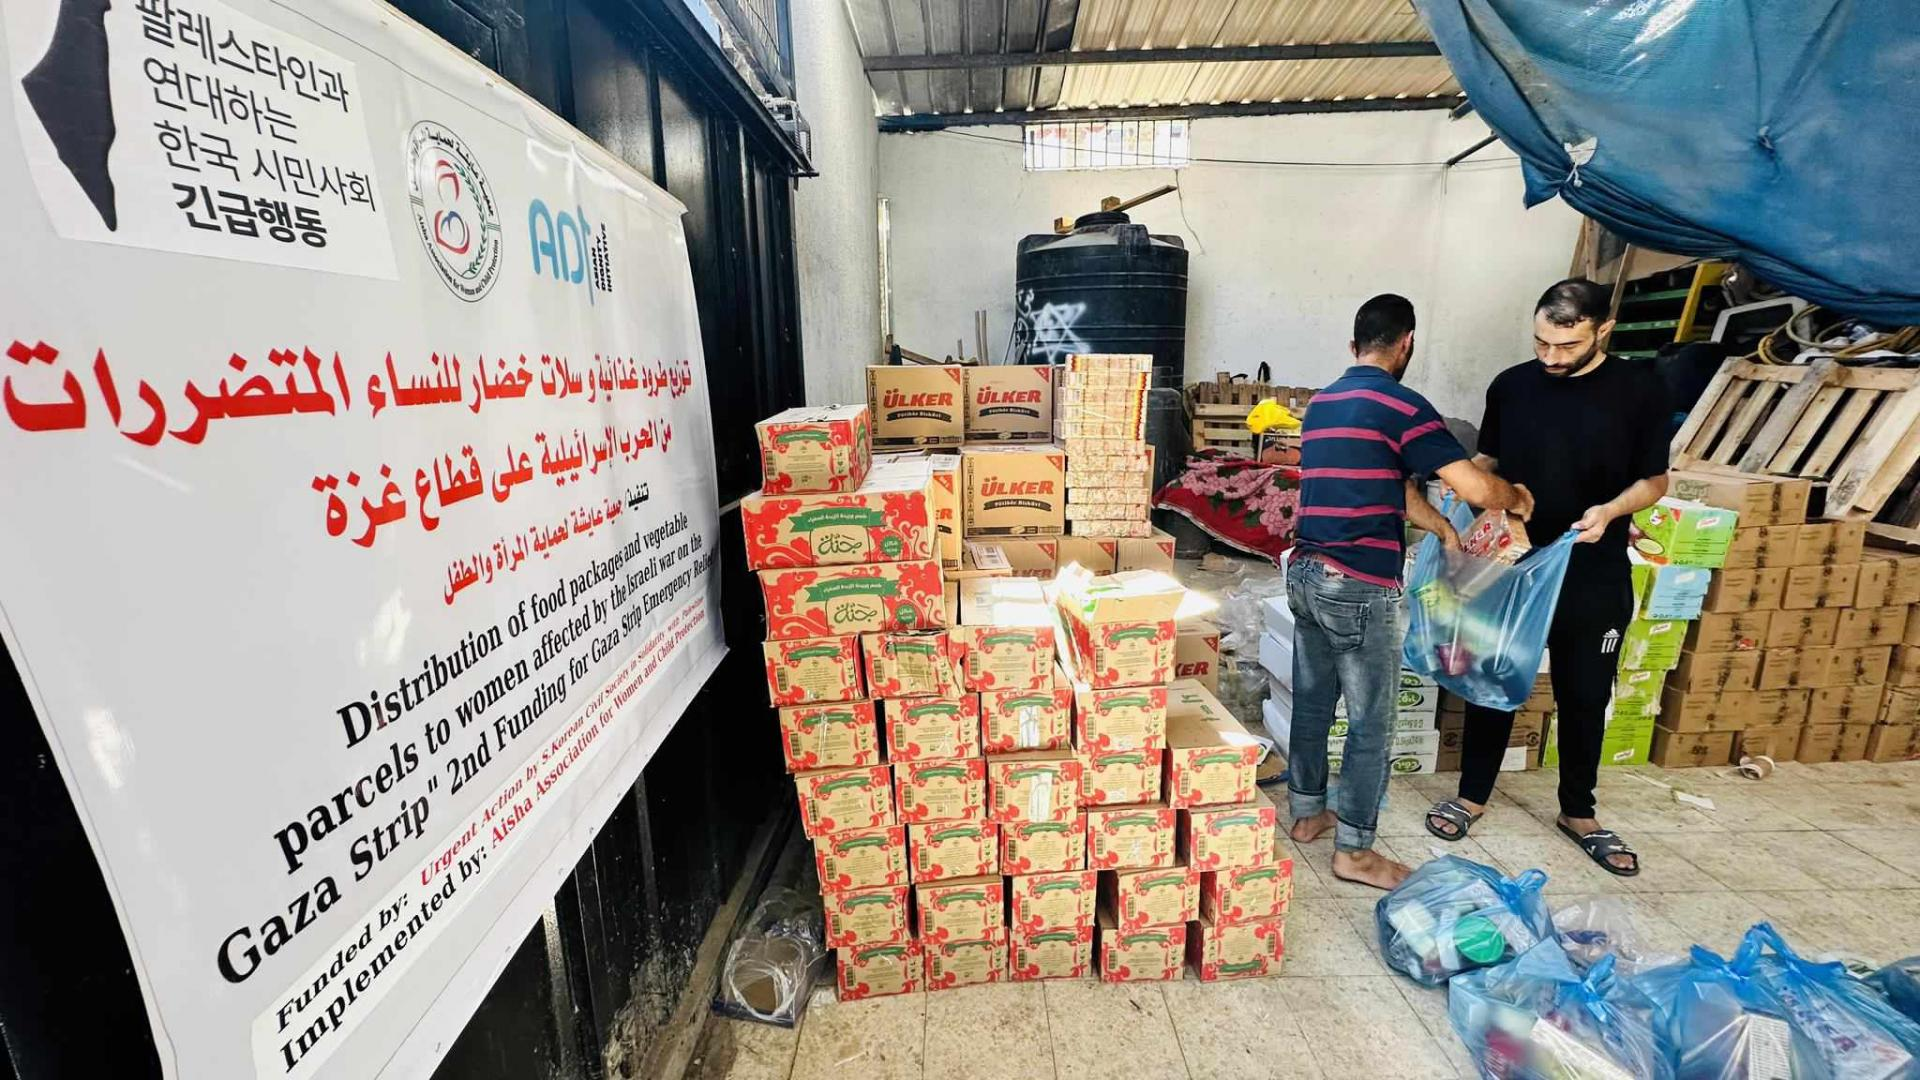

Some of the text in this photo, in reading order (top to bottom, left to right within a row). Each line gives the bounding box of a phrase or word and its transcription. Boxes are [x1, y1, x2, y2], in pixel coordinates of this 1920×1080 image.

[135, 0, 349, 112] 팔레스타인과
[144, 57, 297, 144] 연대하는
[154, 120, 240, 182] 한국
[253, 149, 376, 212] 시민사회
[172, 183, 327, 249] 긴급행동
[3, 340, 351, 446] المتضررات
[367, 351, 462, 418] للنساء
[469, 353, 533, 415] خضار
[642, 359, 668, 397] طرود
[669, 359, 692, 399] توزيع
[883, 388, 953, 408] ÜLKER
[977, 386, 1041, 405] ÜLKER
[620, 420, 658, 463] الحرب
[660, 417, 672, 453] من
[312, 464, 406, 548] غزة
[415, 444, 484, 532] قطاع
[491, 443, 534, 503] على
[981, 477, 1054, 497] ÜLKER
[530, 518, 569, 560] لحماية
[571, 507, 603, 537] عايشة
[444, 551, 493, 605] والطفل
[336, 512, 688, 749] Distribution of food packages and vegetable
[273, 533, 702, 875] parcels to women affected by the Israeli war on the
[216, 876, 342, 984] Gaza
[446, 731, 492, 795] 2nd
[493, 674, 567, 752] Funding
[569, 653, 591, 686] for
[591, 630, 621, 663] Gaza
[621, 604, 643, 637] Strip
[644, 568, 692, 615] Emergency
[276, 924, 373, 1033] Funded
[379, 892, 408, 931] by:
[421, 822, 478, 887] Urgent
[481, 779, 523, 828] Action
[526, 760, 539, 782] by
[585, 694, 604, 719] Civil
[605, 669, 630, 697] Society
[630, 657, 638, 671] in
[280, 609, 705, 1073] Implemented by: Aisha Association for Women and Child Protection
